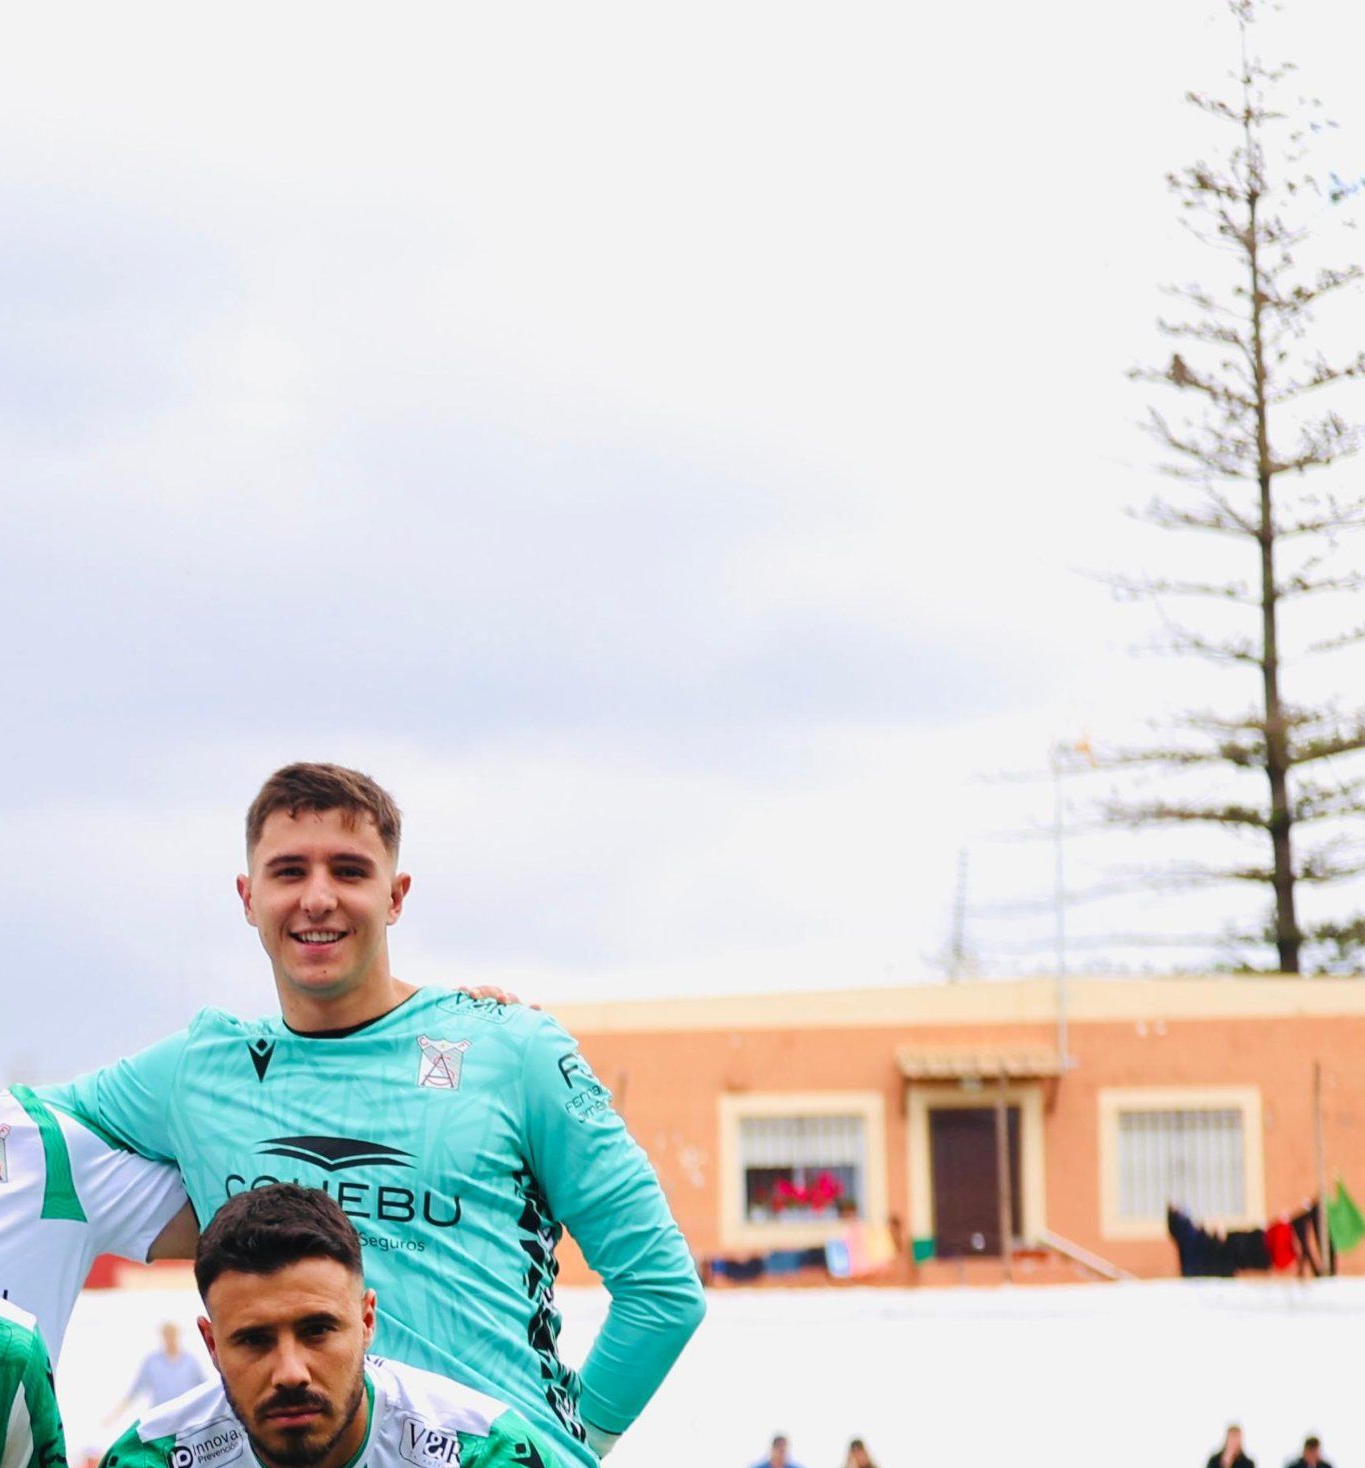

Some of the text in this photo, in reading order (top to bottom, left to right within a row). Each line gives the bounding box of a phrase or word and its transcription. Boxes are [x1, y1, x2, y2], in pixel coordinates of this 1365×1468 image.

[359, 1231, 426, 1252] Seguros
[191, 1429, 239, 1456] Innova
[409, 1422, 464, 1463] V&R
